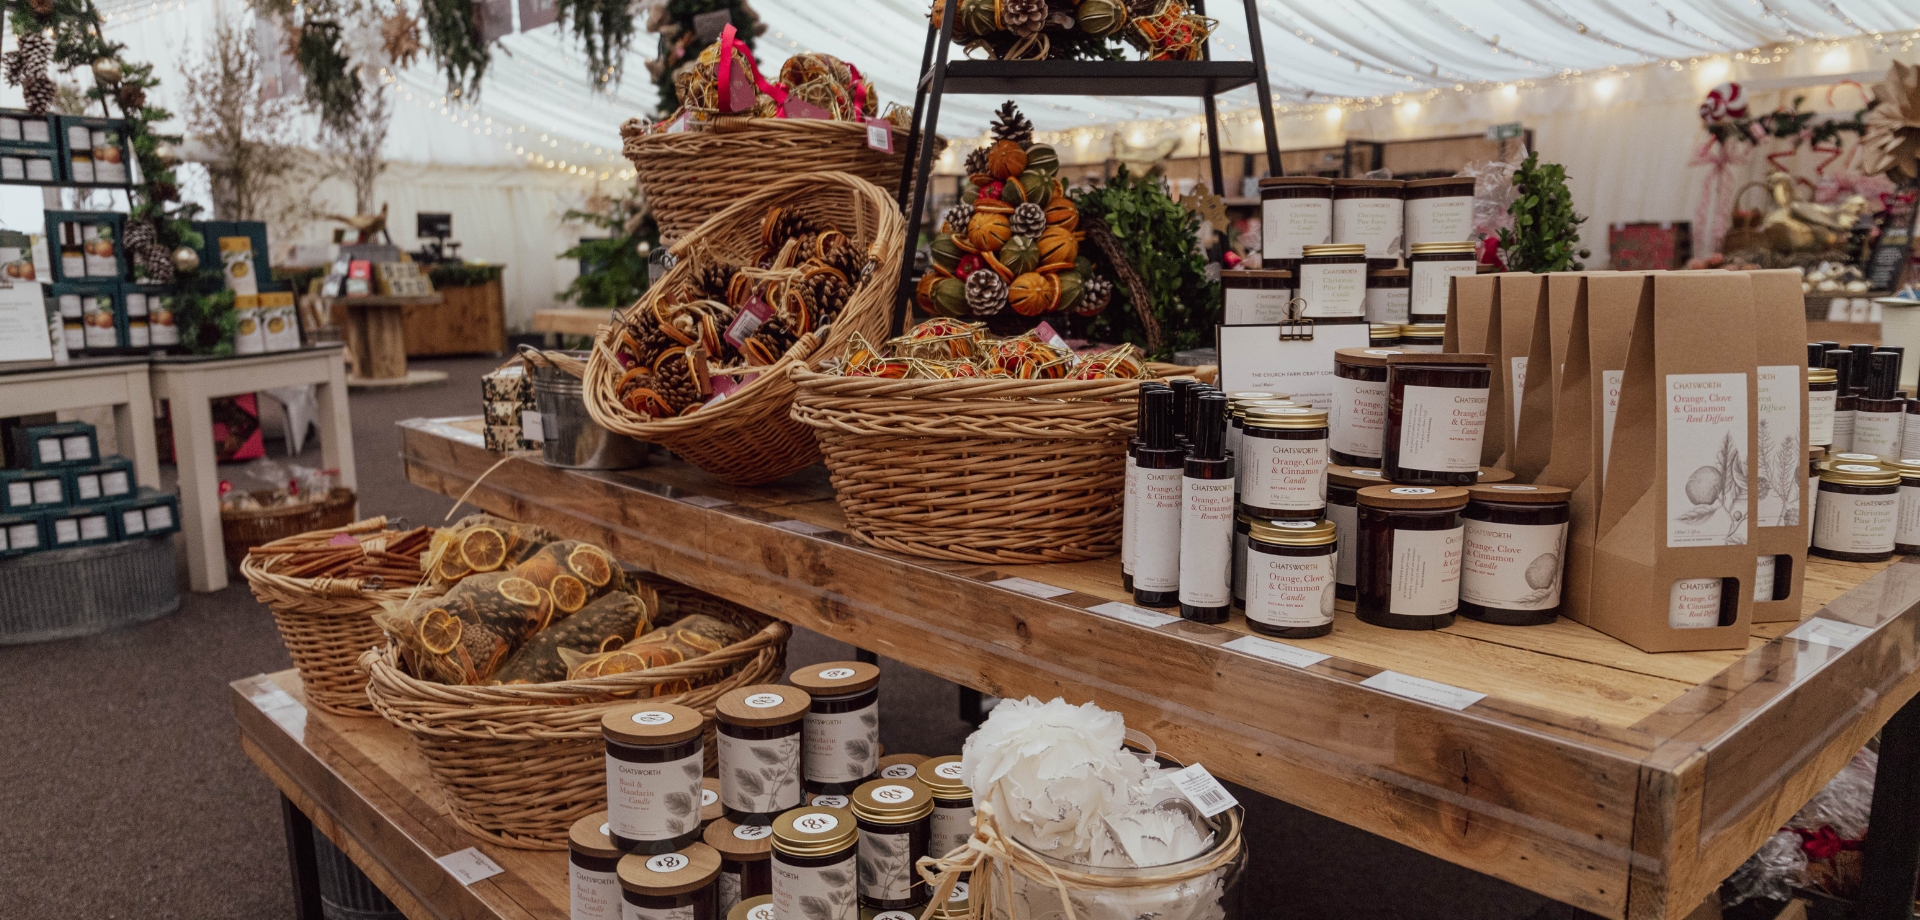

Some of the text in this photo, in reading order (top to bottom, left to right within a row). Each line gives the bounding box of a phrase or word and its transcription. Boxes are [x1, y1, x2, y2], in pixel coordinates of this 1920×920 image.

[1673, 381, 1722, 390] CHATSWORTH
[1355, 387, 1387, 397] CHATSWO
[1673, 394, 1732, 404] Orange, Clove
[1354, 399, 1384, 410] Orange,
[1674, 405, 1726, 413] & Cinnamon
[1759, 403, 1787, 413] Diffuser
[1361, 408, 1383, 416] Cinna
[1452, 409, 1479, 419] Orange,
[1451, 418, 1458, 426] &
[1686, 414, 1734, 425] Reed Diffuser
[1461, 427, 1479, 435] Candle
[1272, 446, 1318, 455] CHATSWORTH
[1271, 457, 1323, 468] Orange, Clove
[1271, 467, 1319, 475] & Cinnamon
[1147, 485, 1173, 494] Orange,
[1191, 496, 1220, 505] Orange,
[1198, 504, 1232, 512] Cinnamon
[1200, 513, 1218, 522] Room
[1467, 526, 1512, 540] CHATSWORTH
[1467, 539, 1495, 552] Orange,
[1497, 545, 1522, 554] Clove
[1473, 549, 1514, 563] Cinnamon
[1269, 561, 1318, 571] CHATSWORTH
[1474, 559, 1498, 570] Candle
[1269, 572, 1325, 584] Orange, Clove
[1268, 582, 1320, 592] & Cinnamon
[1280, 592, 1307, 601] Candle
[1679, 595, 1707, 603] Orange,
[619, 765, 661, 776] CHATSWORTH
[620, 778, 635, 788] Basil
[620, 787, 655, 797] Mandarin
[629, 796, 650, 805] Candle
[576, 872, 615, 885] CHATSWORTH
[577, 884, 598, 896] Basil &
[577, 891, 608, 905] Mandarin
[584, 902, 605, 913] Candle
